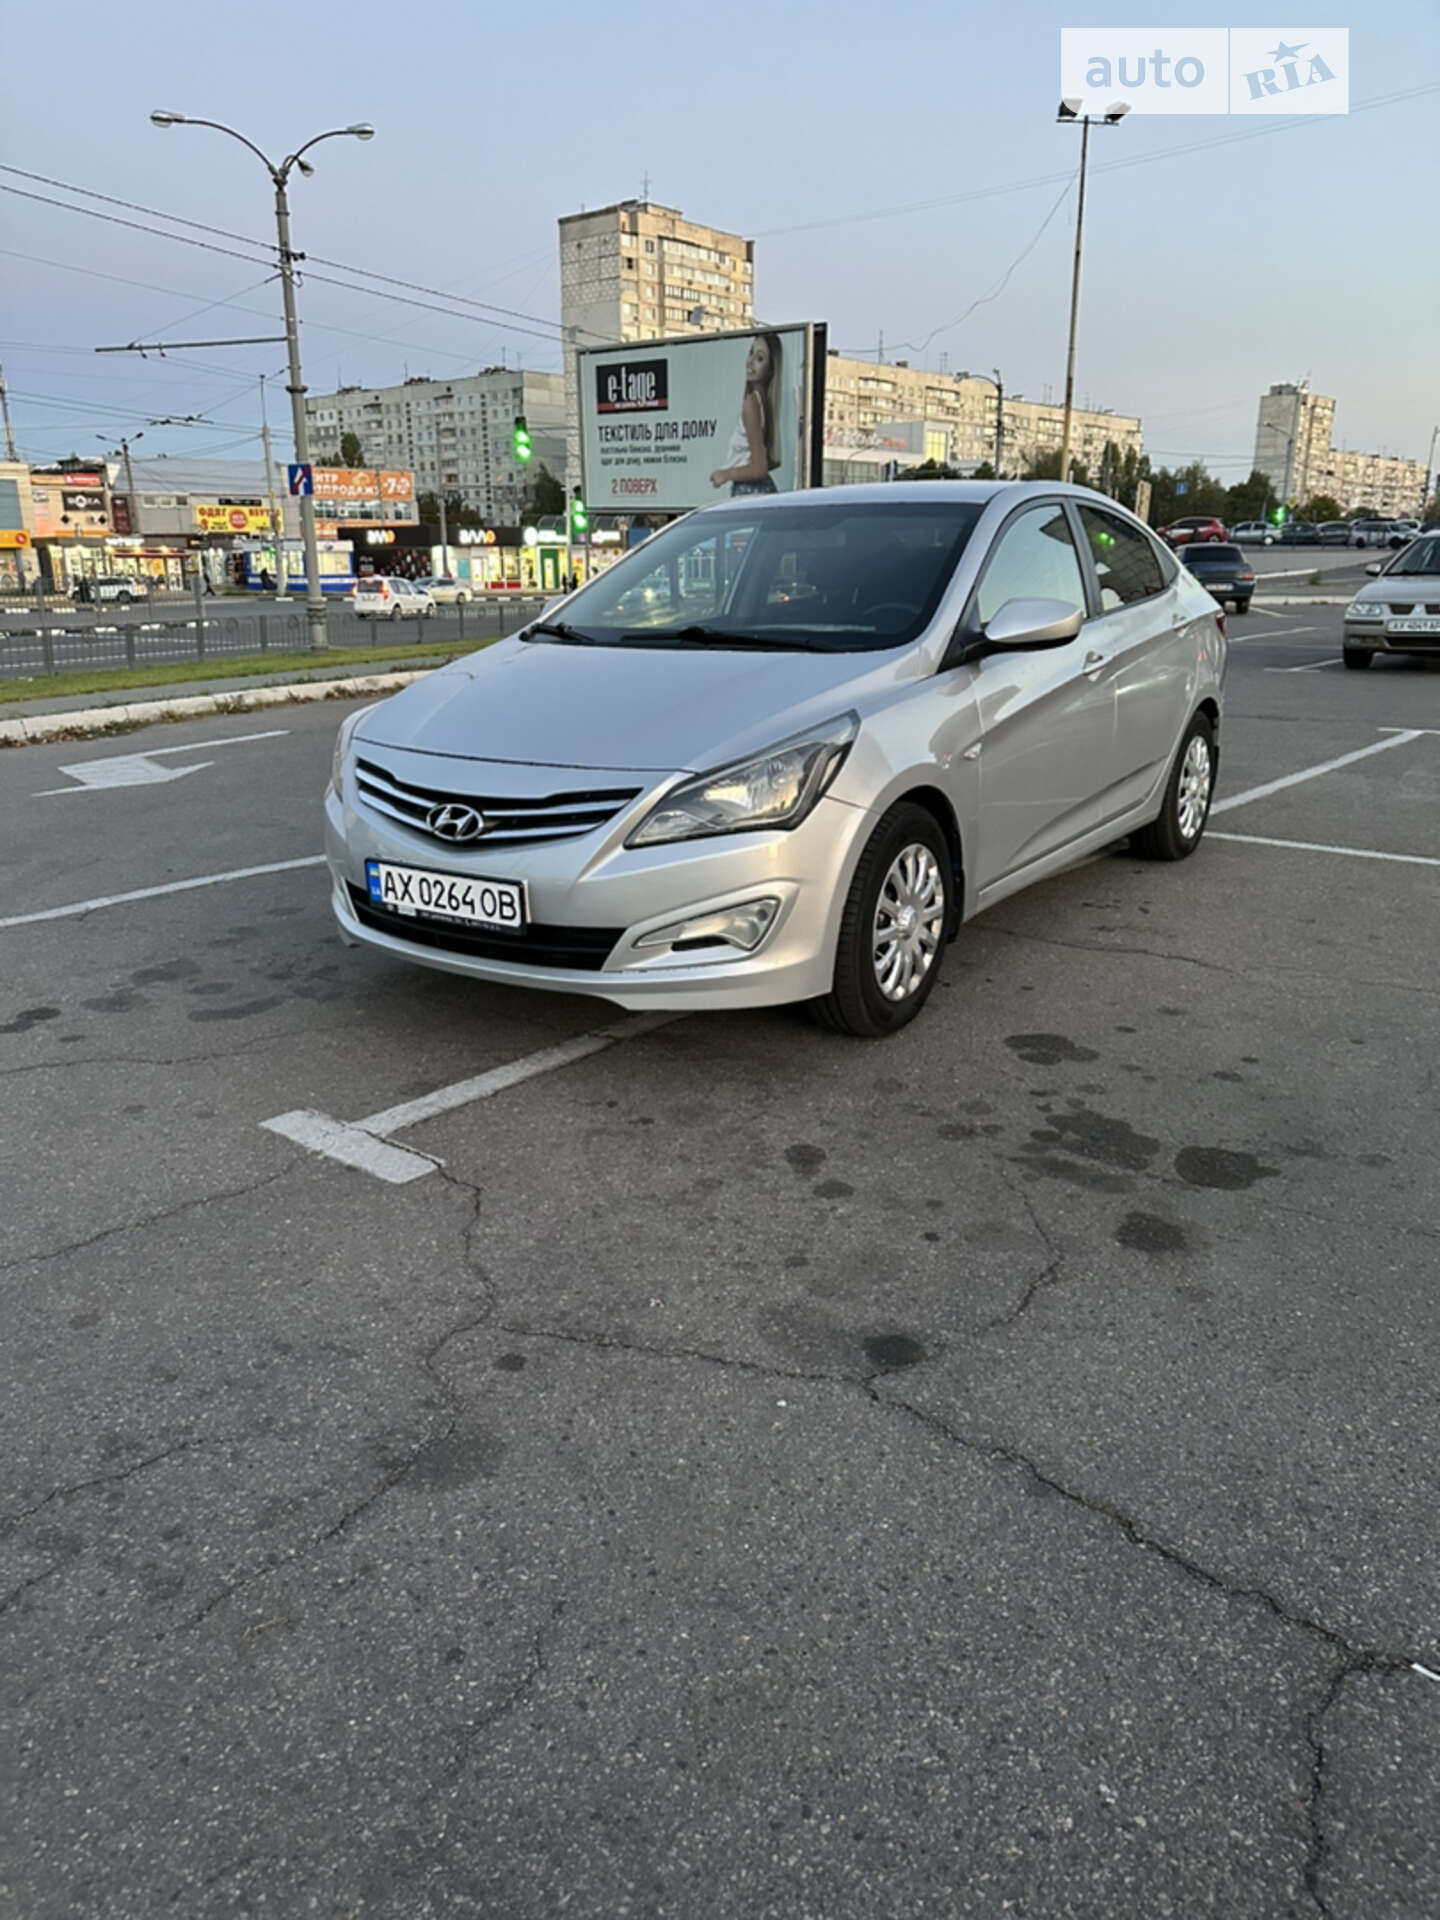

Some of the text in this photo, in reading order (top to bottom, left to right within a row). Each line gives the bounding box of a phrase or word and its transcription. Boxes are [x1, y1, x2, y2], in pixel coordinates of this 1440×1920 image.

[608, 366, 656, 405] e-tage
[598, 420, 717, 443] ТЕКСТИЛЬ ДЛЯ ДОМУ
[611, 478, 657, 495] 2 ПОВЕРХ
[384, 871, 415, 904] AX
[419, 878, 475, 915] 0264
[481, 888, 517, 921] OB
